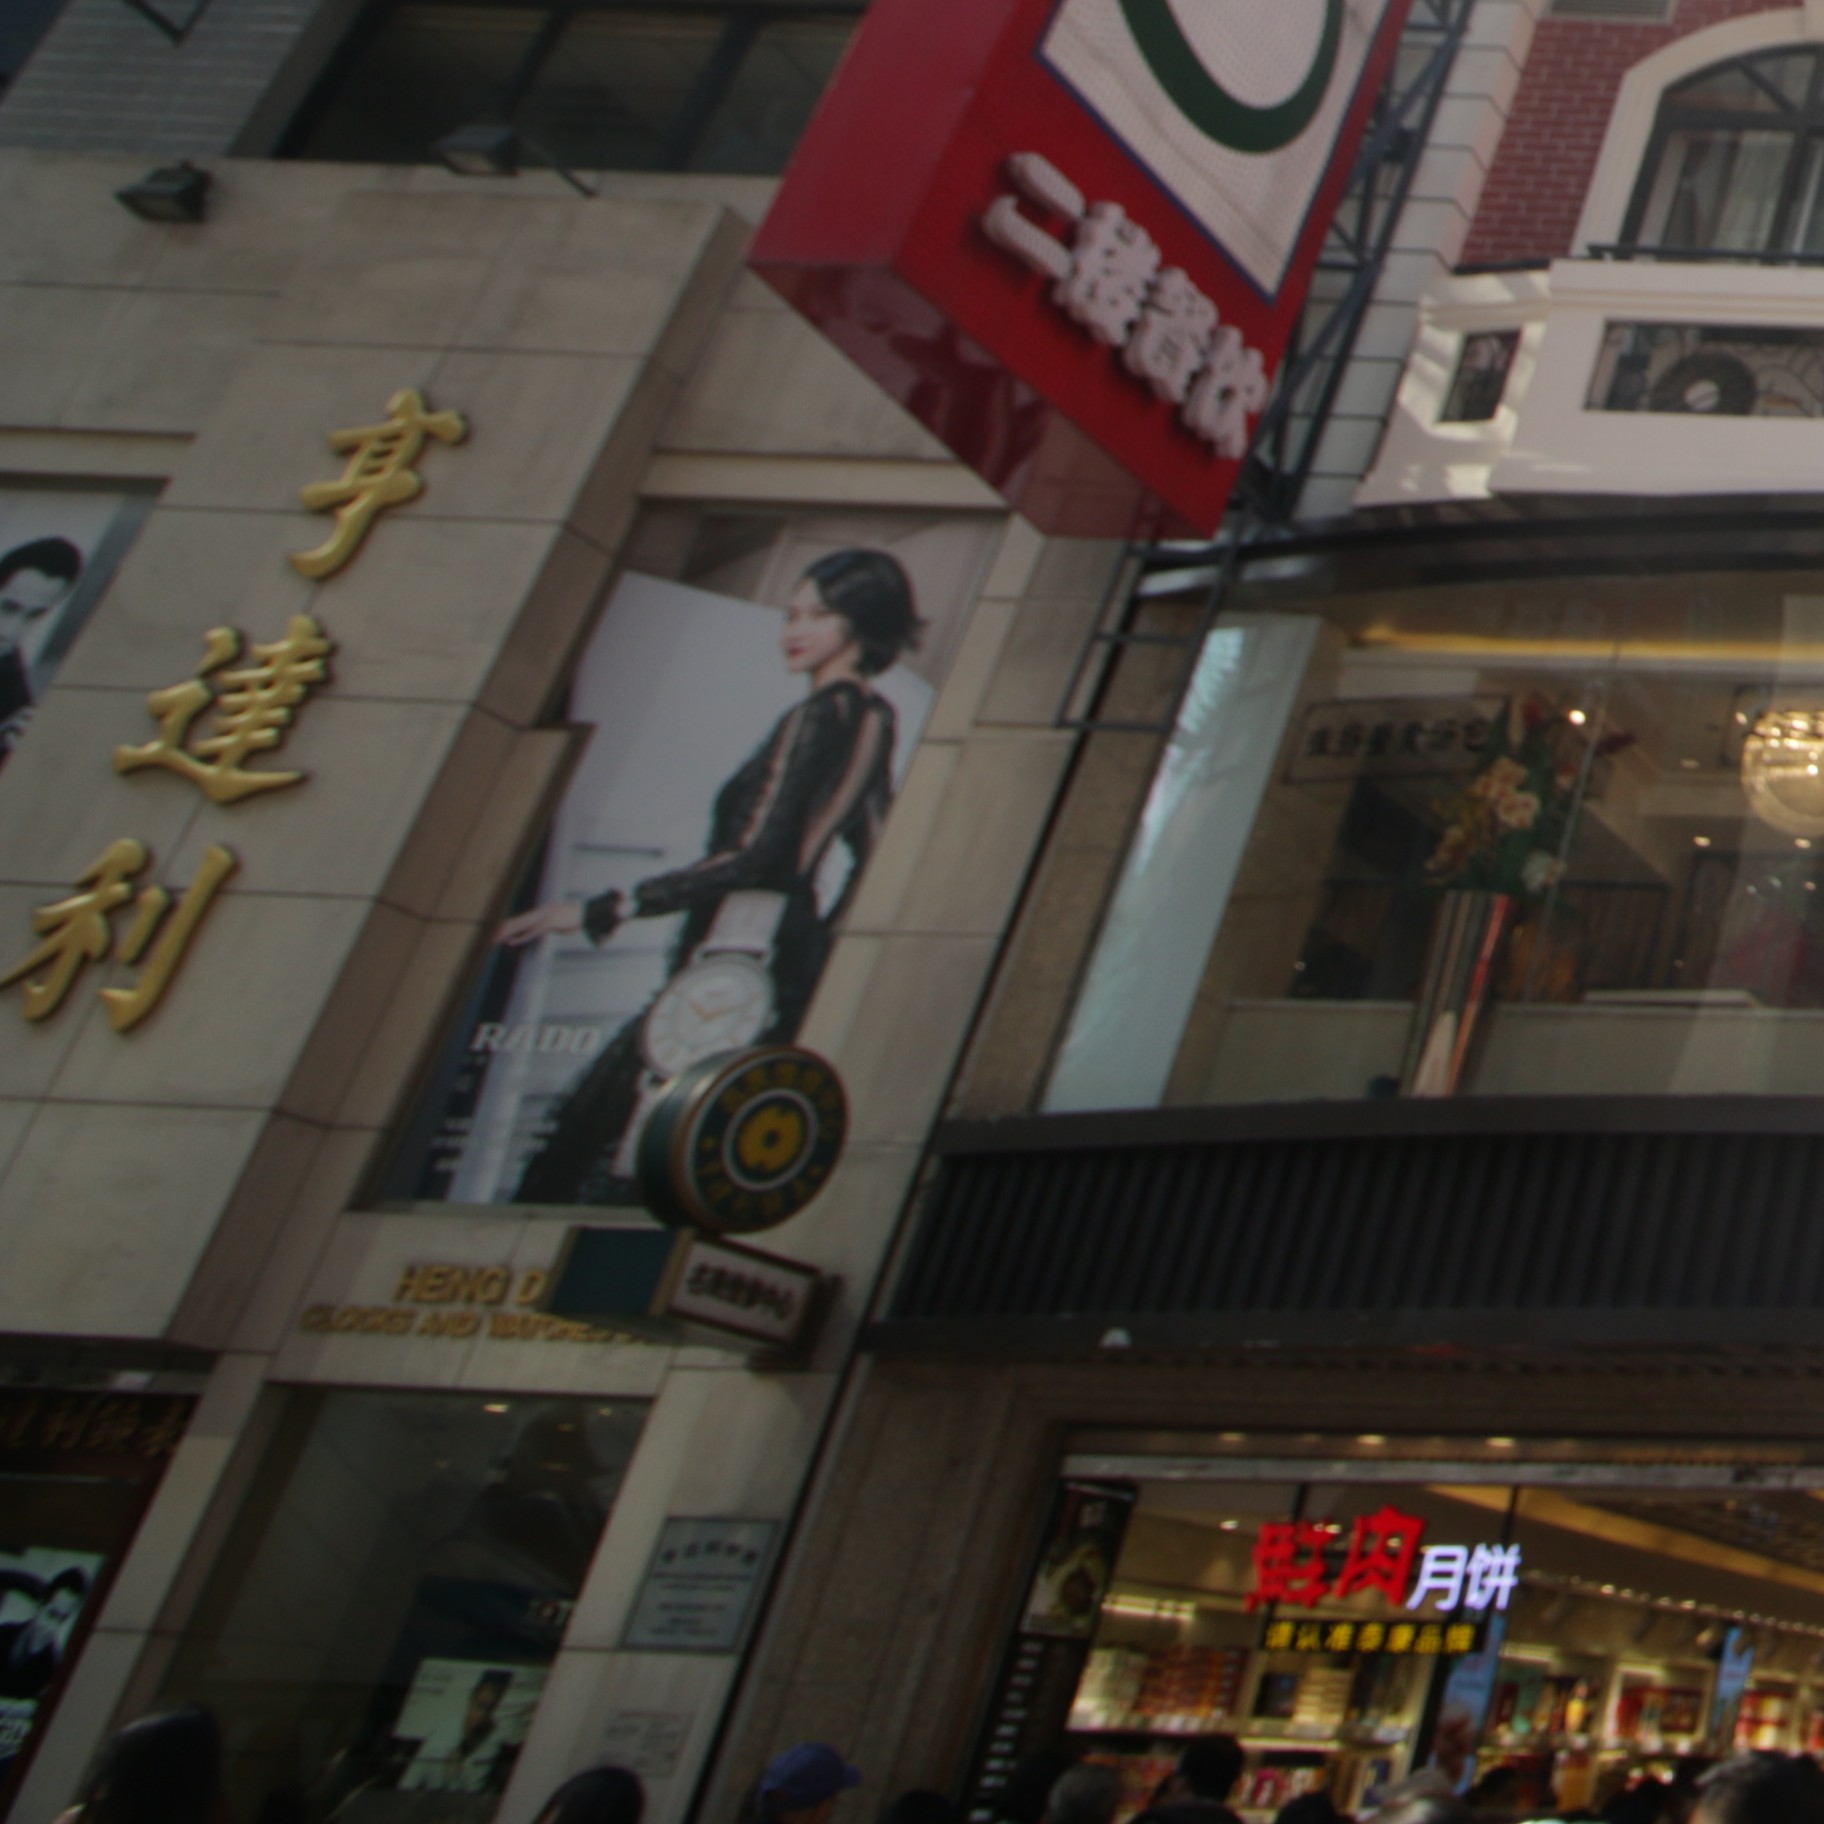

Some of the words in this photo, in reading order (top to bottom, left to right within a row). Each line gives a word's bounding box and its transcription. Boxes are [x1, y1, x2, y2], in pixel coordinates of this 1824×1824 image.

[6, 385, 469, 1034] 亨達利
[469, 1022, 603, 1054] RADO
[396, 1265, 512, 1305] HENG
[416, 1311, 482, 1339] AND
